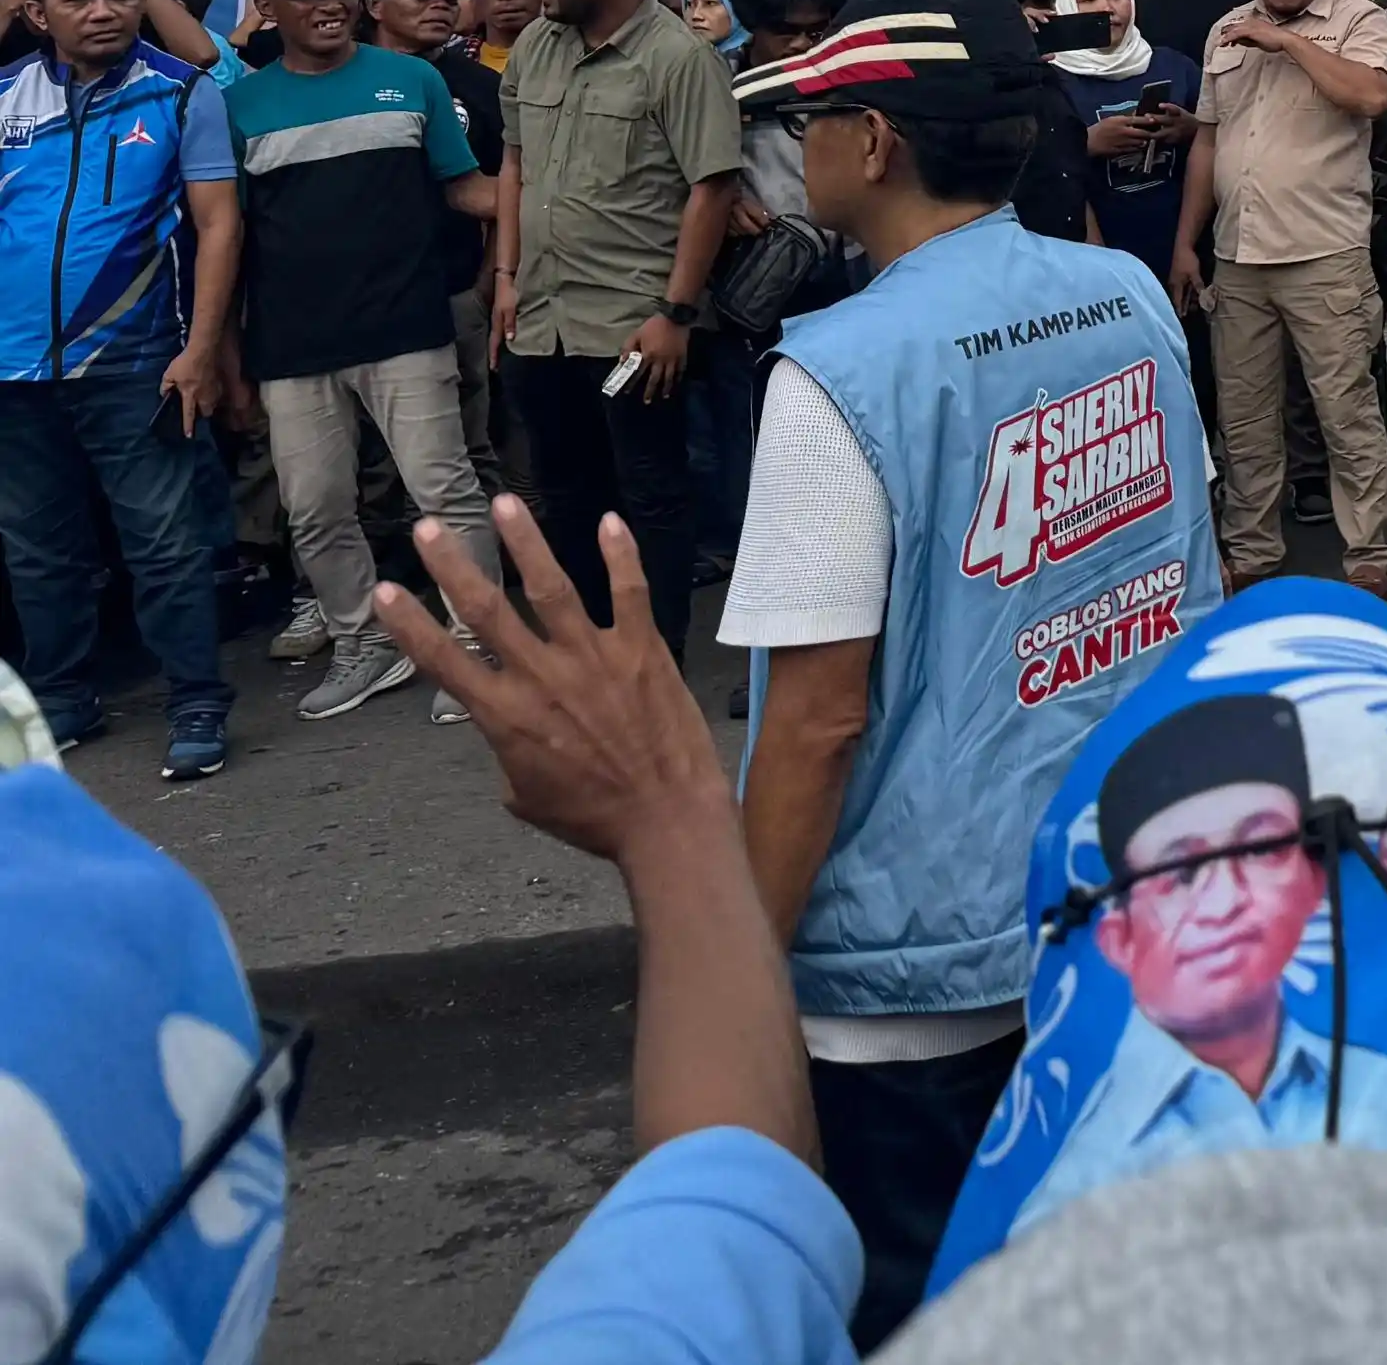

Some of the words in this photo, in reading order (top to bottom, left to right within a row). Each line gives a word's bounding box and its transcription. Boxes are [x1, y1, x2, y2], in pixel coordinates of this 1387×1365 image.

[955, 328, 1003, 360] TIM
[1007, 296, 1132, 347] KAMPANYE
[1041, 364, 1151, 465] SHERLY
[965, 411, 1042, 585] 4
[1042, 415, 1159, 521] SARBIN
[1052, 507, 1094, 535] BERSAMA
[1095, 489, 1124, 514] MALUT
[1016, 592, 1112, 659] COBLOS
[1116, 561, 1184, 610] YANG
[1018, 589, 1184, 707] CANTIK
